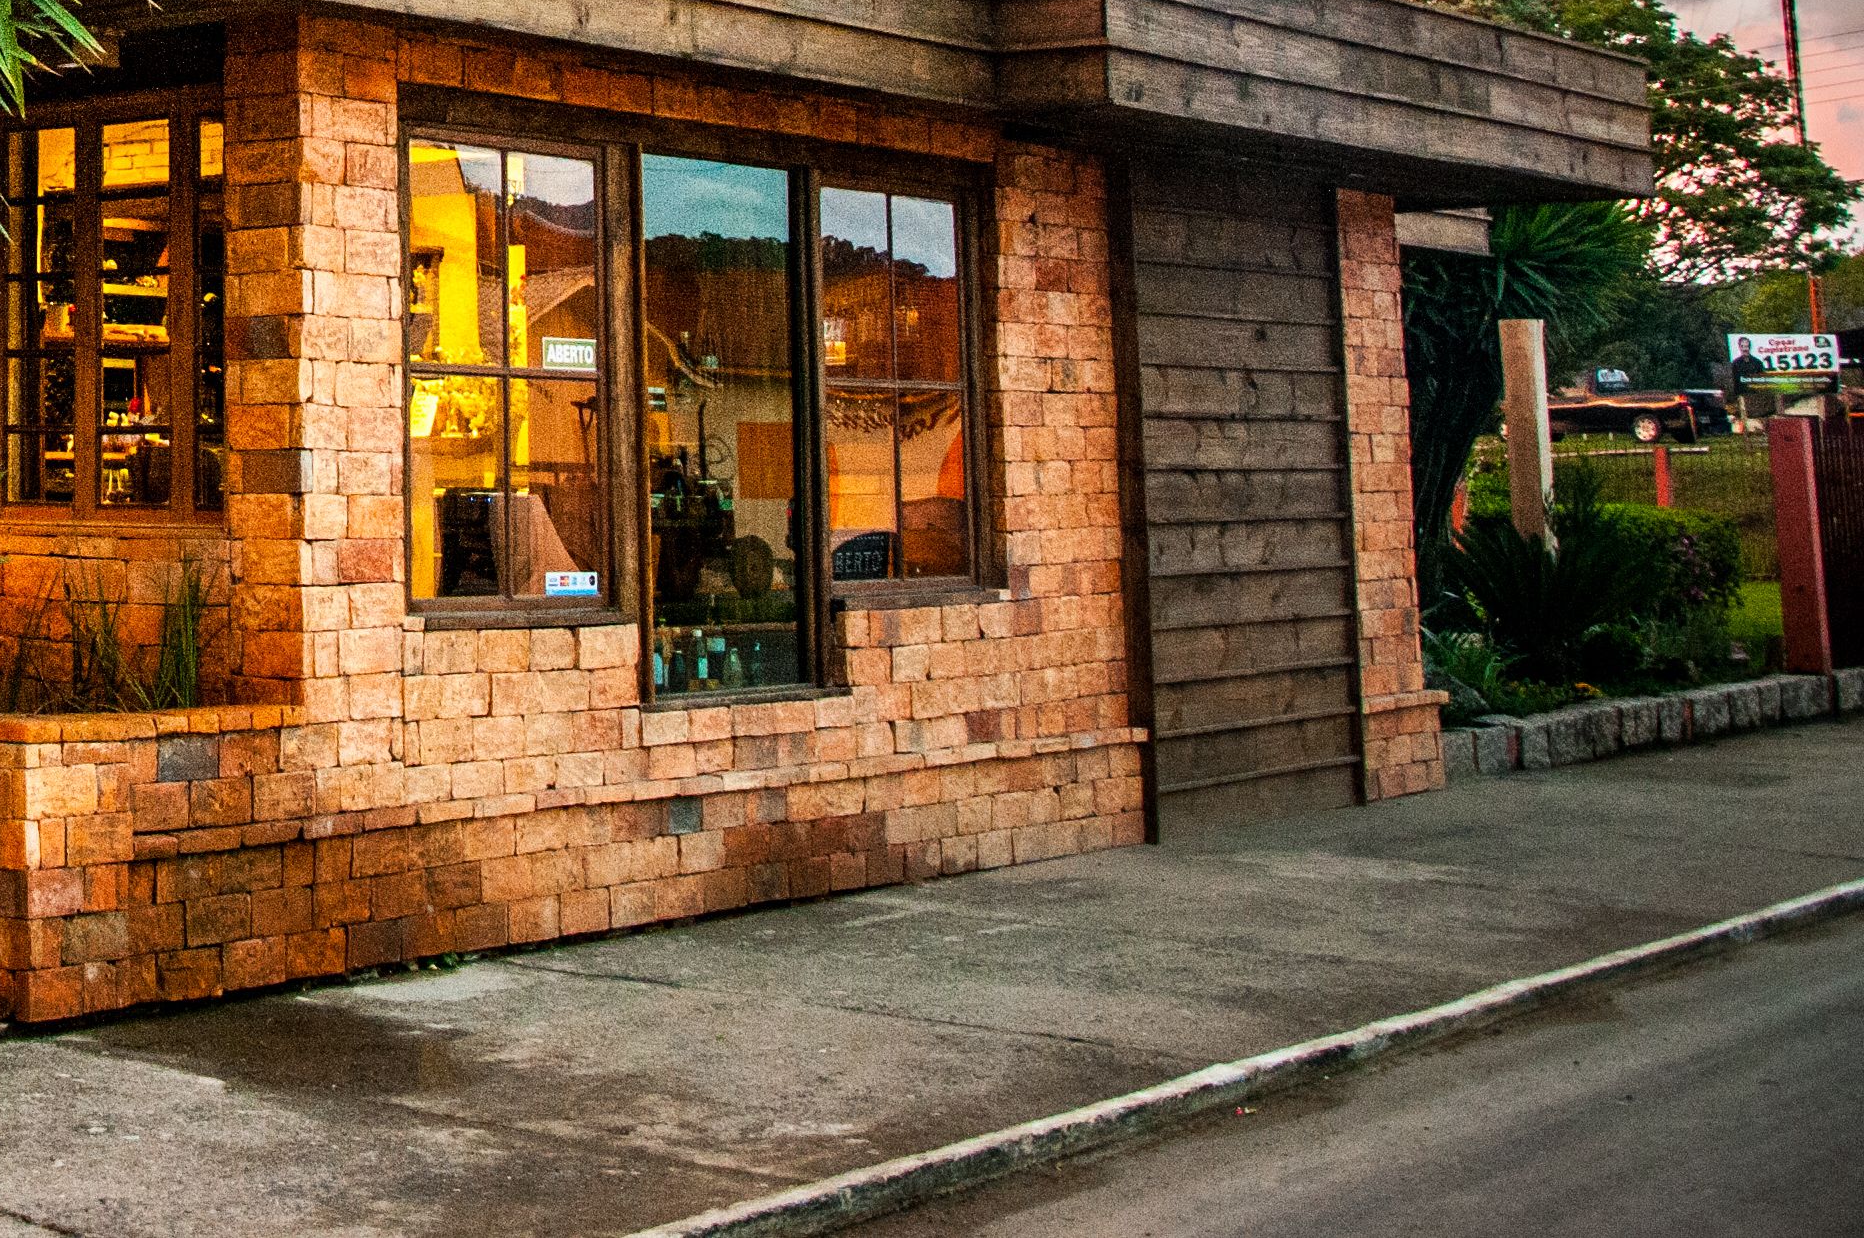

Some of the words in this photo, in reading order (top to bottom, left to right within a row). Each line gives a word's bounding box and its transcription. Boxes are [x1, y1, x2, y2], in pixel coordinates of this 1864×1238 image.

[546, 343, 594, 364] ABERTO
[1763, 352, 1834, 371] 15123
[835, 551, 883, 572] BERTO
